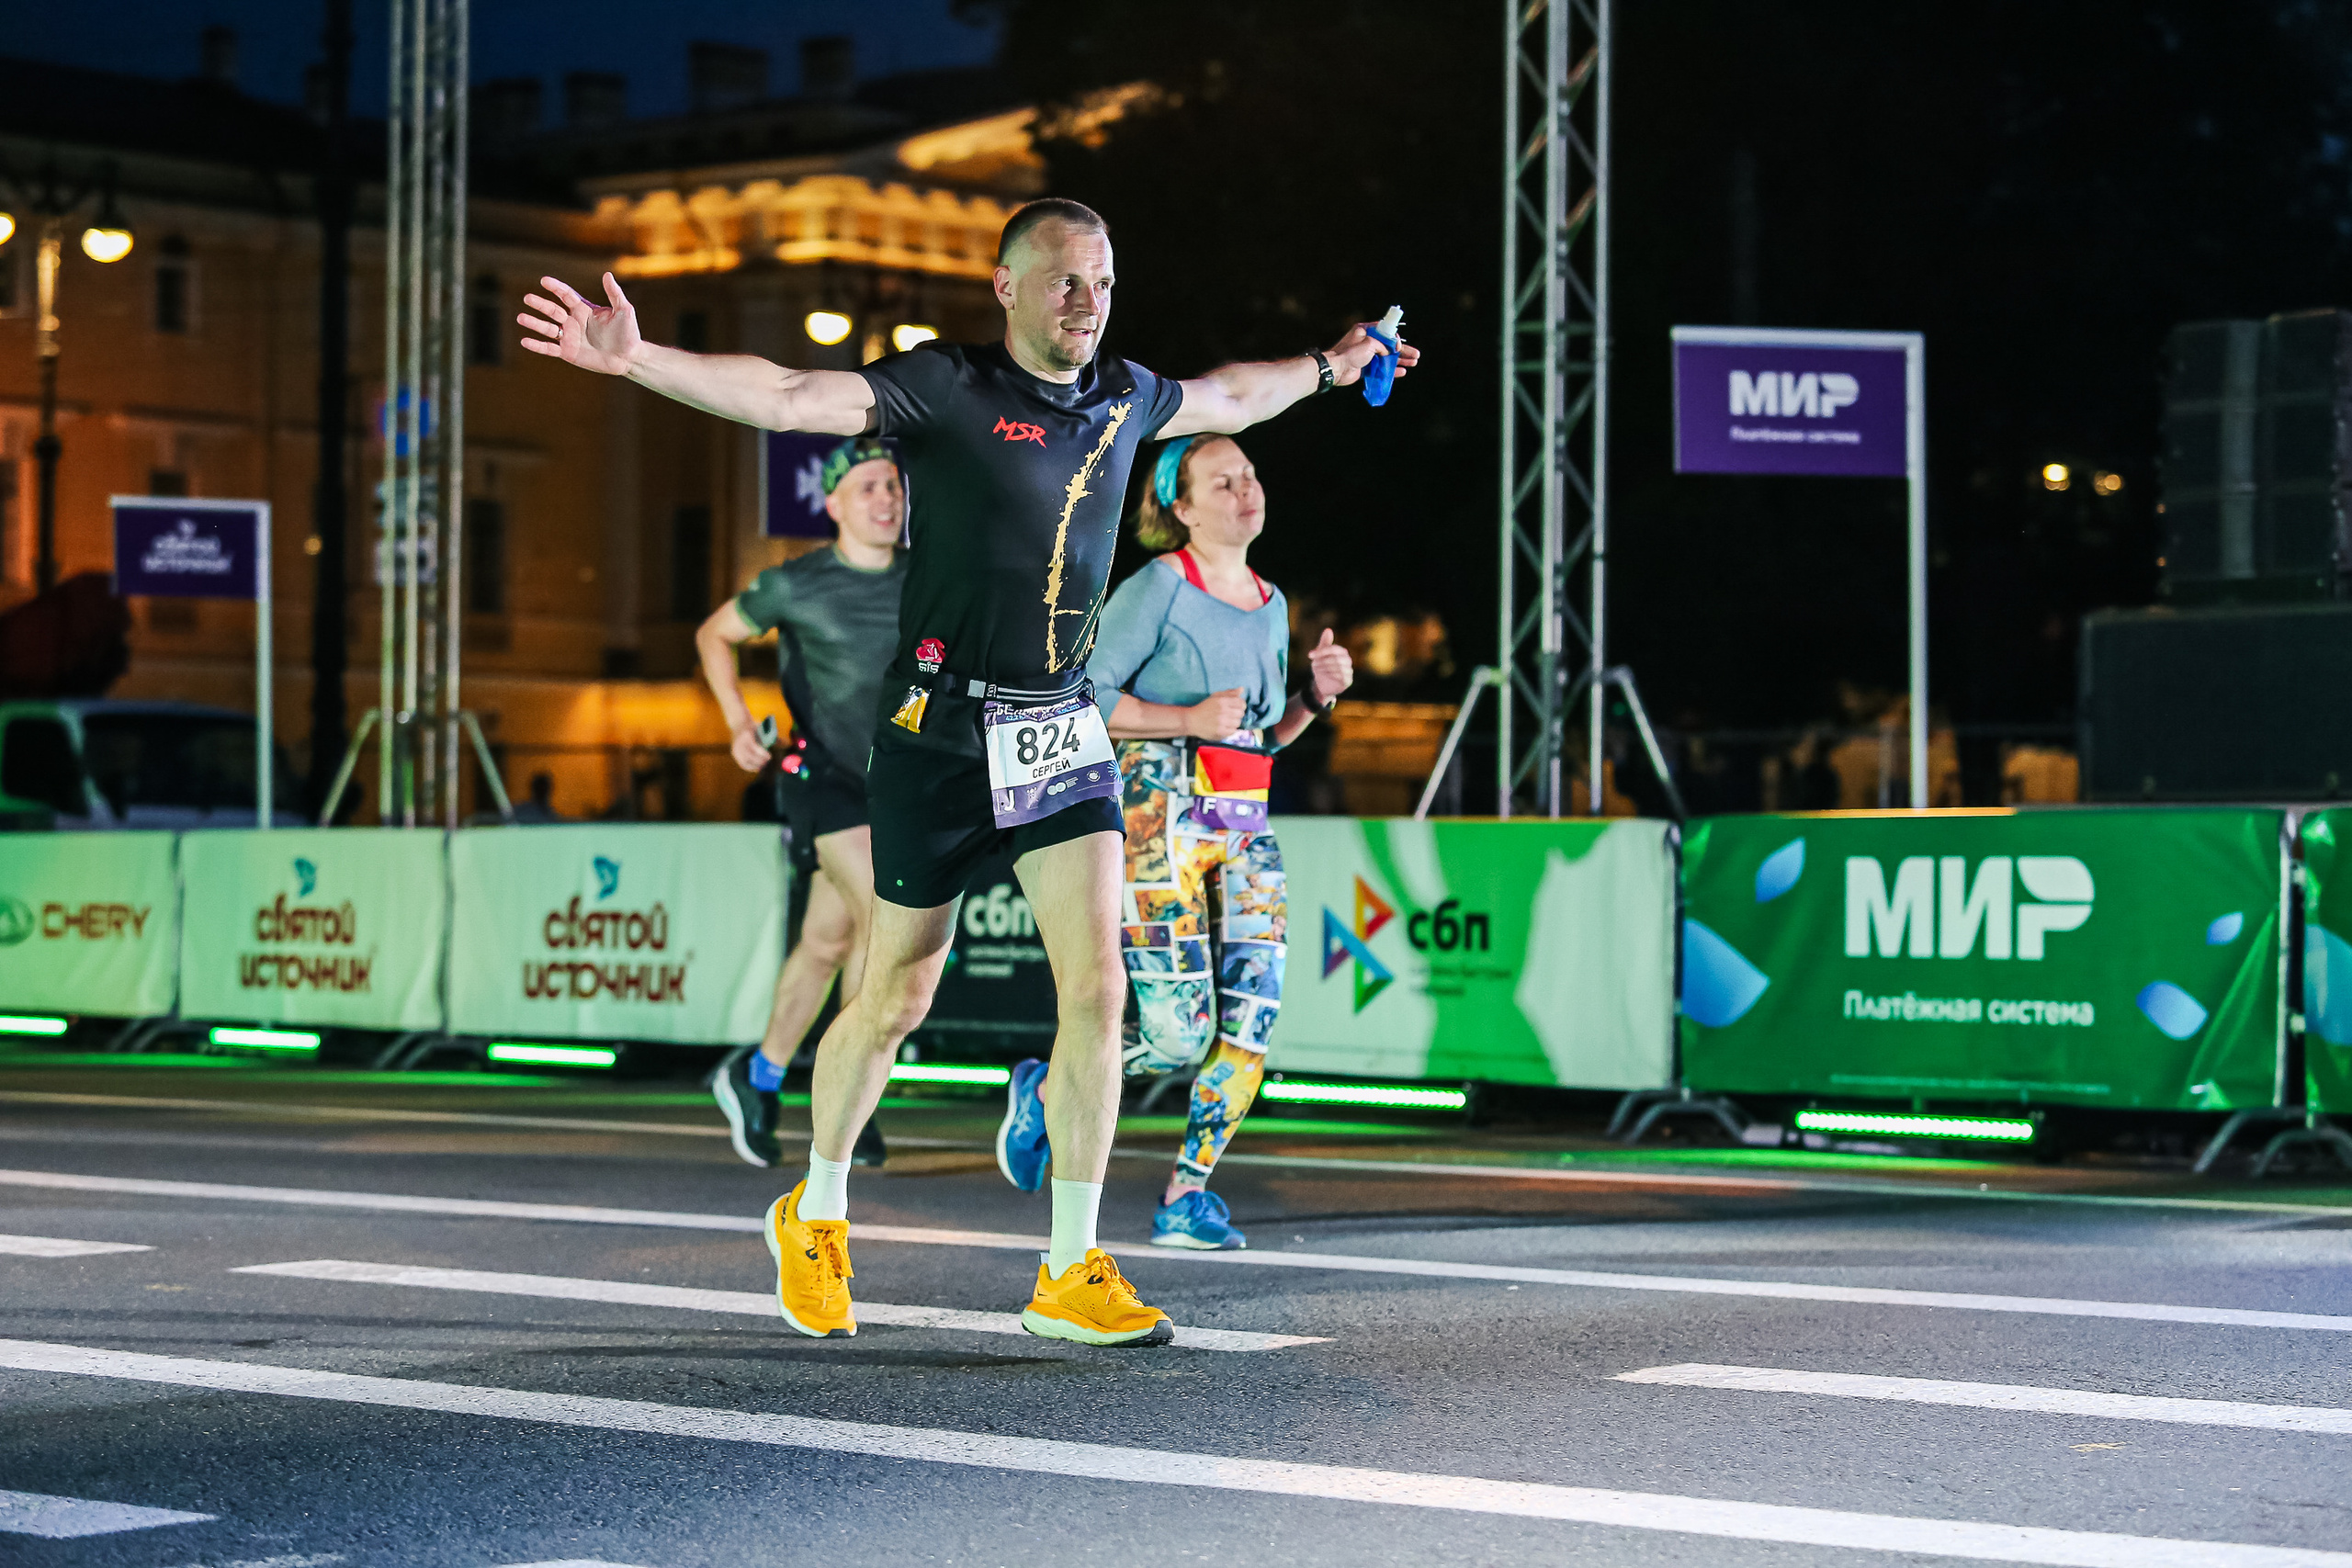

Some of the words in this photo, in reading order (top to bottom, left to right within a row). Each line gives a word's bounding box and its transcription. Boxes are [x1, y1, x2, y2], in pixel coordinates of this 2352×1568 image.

[1729, 370, 1860, 418] МИР
[992, 416, 1046, 448] MSR
[1016, 717, 1080, 765] 824
[1033, 758, 1071, 779] СЕРГЕЙ
[43, 902, 152, 940] CHERY
[1407, 899, 1490, 952] сбп
[1845, 856, 2095, 961] МИР
[1987, 998, 2095, 1026] система
